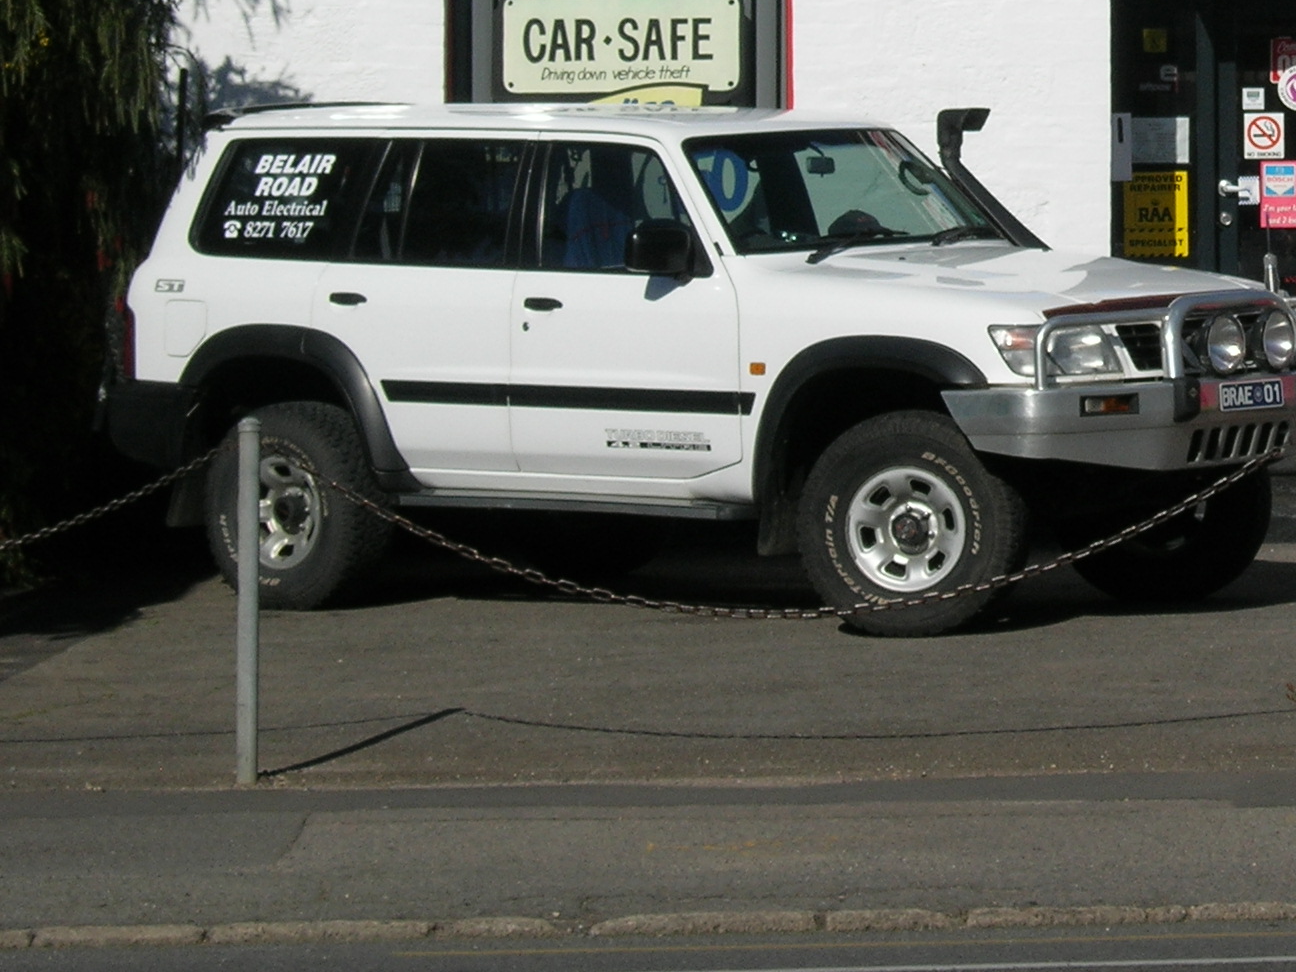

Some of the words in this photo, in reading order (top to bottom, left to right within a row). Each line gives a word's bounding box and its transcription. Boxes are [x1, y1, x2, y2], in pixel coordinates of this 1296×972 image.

[540, 66, 576, 84] Driving
[577, 66, 607, 81] down
[611, 65, 656, 81] vehicle
[659, 64, 691, 81] theft
[254, 154, 337, 175] BELAIR
[254, 176, 319, 197] ROAD
[1132, 174, 1183, 183] PPROVED
[223, 200, 259, 217] Auto
[261, 199, 329, 217] Electrical
[1137, 207, 1174, 223] RAA
[243, 221, 275, 238] 8271
[279, 221, 315, 238] 7617
[1222, 385, 1253, 407] BRAE
[1263, 382, 1281, 404] 01
